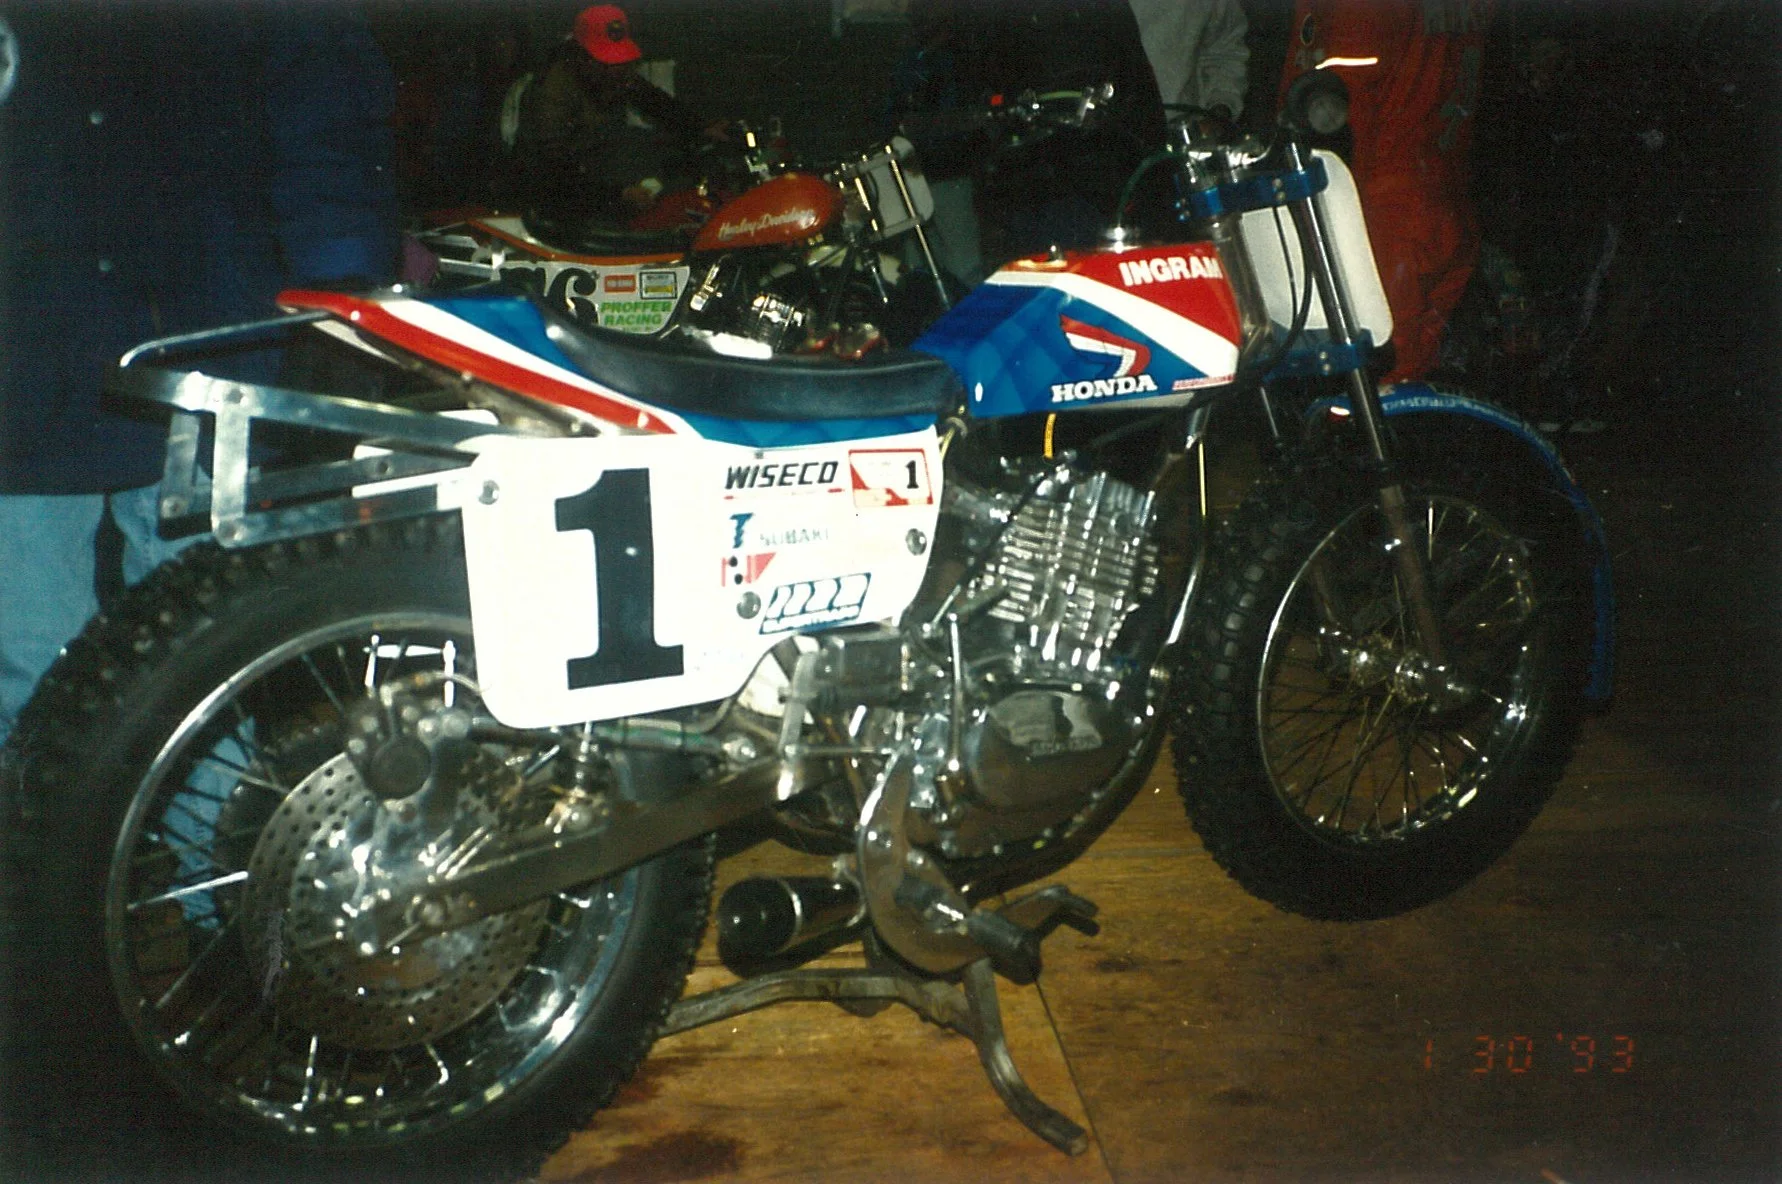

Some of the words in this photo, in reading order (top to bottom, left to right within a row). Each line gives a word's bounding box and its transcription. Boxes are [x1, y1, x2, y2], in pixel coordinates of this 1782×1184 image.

[1119, 256, 1223, 287] INGRAM
[600, 301, 673, 314] PROFFER
[604, 313, 662, 326] RACING
[1051, 374, 1158, 402] HONDA
[725, 461, 839, 490] WISECO
[905, 459, 919, 490] 1
[554, 467, 684, 690] 1
